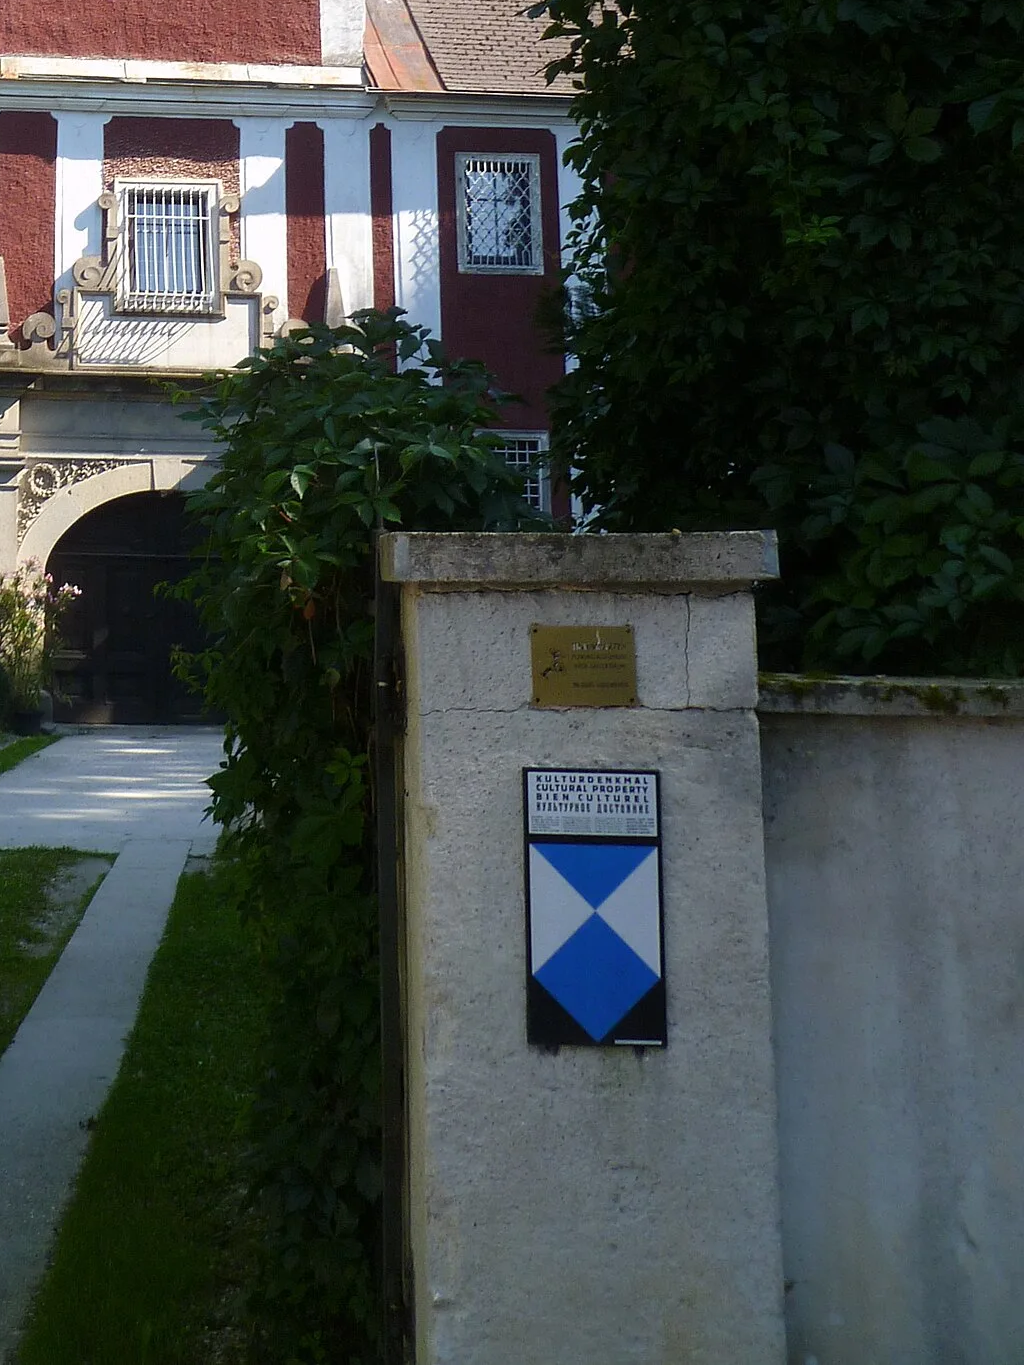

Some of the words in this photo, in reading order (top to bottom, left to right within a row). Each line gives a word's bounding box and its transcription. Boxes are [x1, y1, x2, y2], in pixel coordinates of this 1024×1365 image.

[536, 775, 648, 785] KULTURDENKMAL
[536, 784, 587, 793] CULTURAL
[592, 785, 648, 794] PROPERTY
[536, 793, 569, 802] BIEN
[578, 794, 649, 803] CULTUREL
